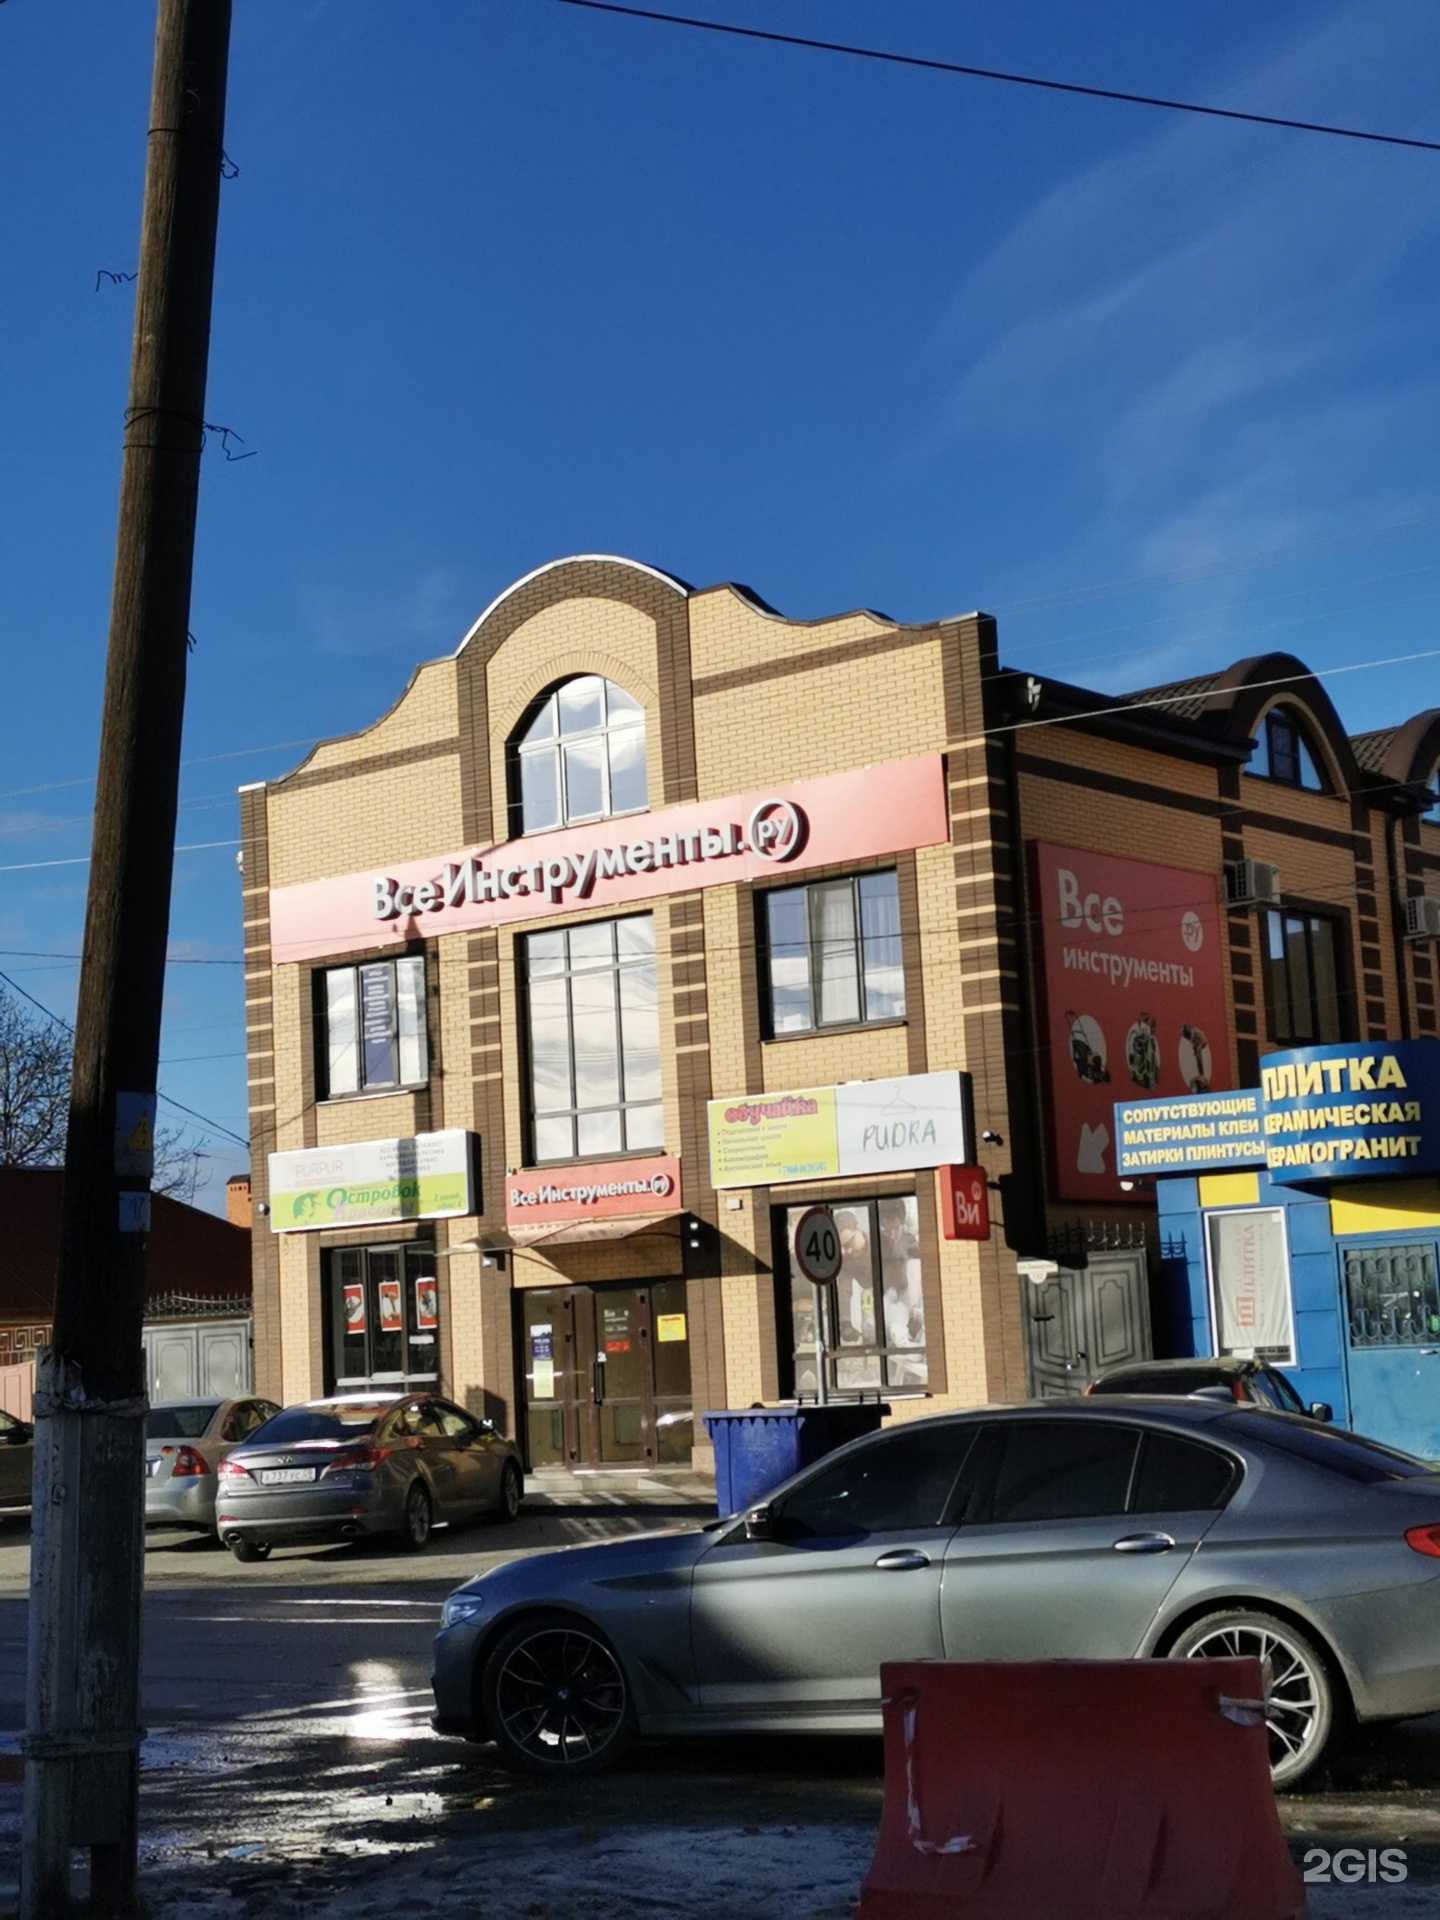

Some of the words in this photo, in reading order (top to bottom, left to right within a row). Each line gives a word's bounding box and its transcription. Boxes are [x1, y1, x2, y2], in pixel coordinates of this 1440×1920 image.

[1058, 869, 1124, 936] Все
[1063, 947, 1194, 987] инструменты
[1261, 1055, 1407, 1101] ПЛИТКА
[1123, 1097, 1257, 1124] СОПУТСТВУЮЩИЕ
[862, 1119, 936, 1151] PUDRA
[1123, 1122, 1215, 1145] МАТЕРИАЛЫ
[1122, 1149, 1184, 1167] ЗАТИРКИ
[1186, 1140, 1266, 1161] ПЛИНТУСЫ
[806, 1230, 836, 1262] 40
